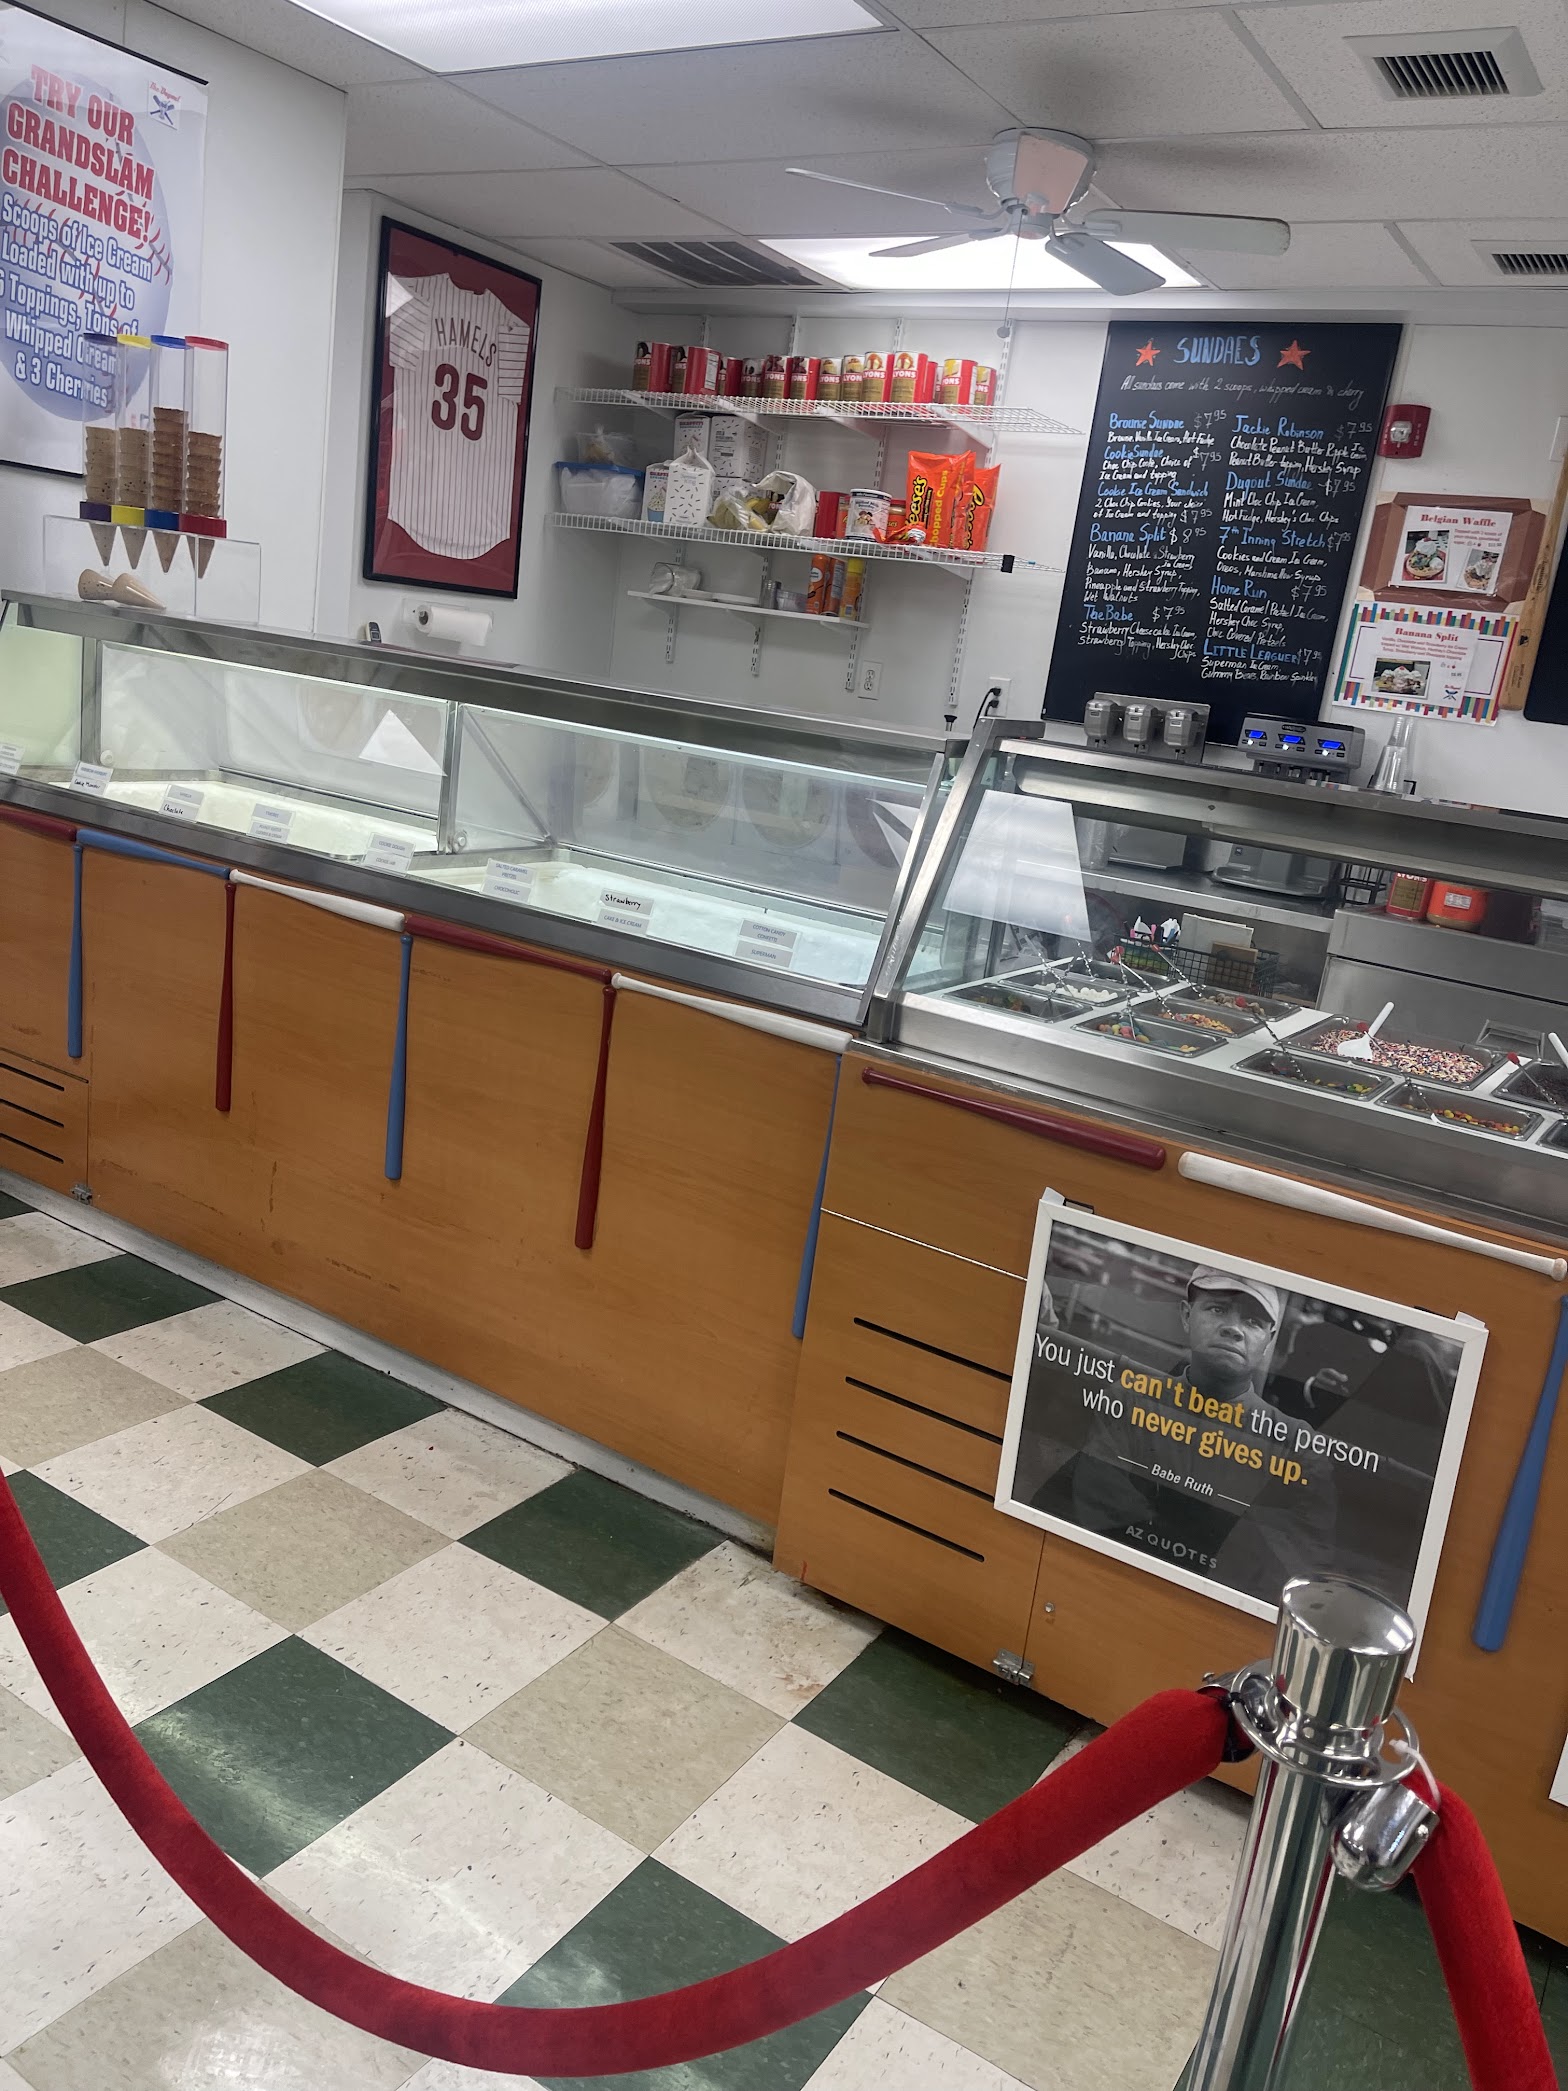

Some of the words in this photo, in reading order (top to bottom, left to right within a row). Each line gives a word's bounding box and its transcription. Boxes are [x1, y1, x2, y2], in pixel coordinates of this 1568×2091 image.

[31, 64, 81, 118] TRY
[87, 95, 134, 146] OUR
[8, 103, 154, 200] GRANDSLAM
[3, 149, 151, 243] CHALLENGE!
[2, 193, 58, 241] Scoops
[62, 220, 80, 249] of
[80, 225, 103, 260] Ice
[106, 237, 152, 282] Cream
[2, 232, 56, 279] Loaded
[61, 260, 94, 293] with
[97, 276, 116, 307] up
[119, 280, 135, 310] to
[9, 273, 80, 330] Toppings,
[85, 301, 118, 337] Tons
[5, 309, 77, 360] Whipped
[434, 318, 496, 367] HAMELS
[1173, 336, 1260, 366] SUNDAES
[15, 350, 26, 380] &
[31, 357, 42, 385] 3
[1188, 377, 1209, 391] with
[1214, 378, 1223, 390] 2
[431, 363, 488, 441] 35
[1109, 412, 1147, 429] Brownie
[1232, 415, 1271, 435] Jackie
[1277, 416, 1324, 439] Robinson
[1104, 444, 1133, 459] Cookie
[1133, 443, 1164, 458] Sundae
[1230, 435, 1268, 451] Chocolate
[1269, 437, 1295, 453] Peanut
[1297, 439, 1325, 455] Butter
[1183, 456, 1192, 468] of
[1229, 451, 1251, 466] Peanut
[1251, 453, 1277, 467] Butter
[936, 470, 949, 497] Cups
[1097, 481, 1127, 497] Cookie
[1128, 482, 1143, 496] Ice
[1144, 482, 1168, 497] Cream
[1170, 481, 1208, 498] Sandwich
[1225, 471, 1271, 499] Dugout
[1275, 474, 1313, 491] Sundae
[905, 475, 927, 525] eese's
[1095, 498, 1102, 508] 2
[1223, 492, 1247, 508] Mint
[1265, 491, 1282, 516] Chip
[930, 500, 943, 547] hopped
[1093, 509, 1103, 518] of
[1136, 509, 1150, 518] and
[1222, 509, 1237, 523] Hot
[1420, 514, 1458, 524] Belgian
[1463, 516, 1496, 527] Waffle
[1090, 522, 1135, 542] Banana
[1139, 522, 1167, 549] Split
[1240, 527, 1277, 551] Inning
[1281, 530, 1326, 548] Stretch
[1119, 544, 1151, 560] Chocolate
[1217, 545, 1250, 562] Cookies
[1251, 551, 1265, 562] and
[1264, 550, 1287, 564] Cream
[1122, 563, 1153, 582] Hershey
[1244, 565, 1294, 580] Marshmallow
[1083, 591, 1098, 603] Wet
[1085, 576, 1121, 594] Pineapple
[1123, 579, 1138, 591] and
[1139, 579, 1178, 600] Strawberry
[1210, 575, 1241, 596] Home
[1244, 579, 1267, 598] Run
[1083, 604, 1104, 620] The
[1105, 604, 1134, 620] Babe
[1209, 597, 1241, 611] Salted
[1240, 600, 1270, 614] Caramel
[1208, 611, 1240, 632] Hershey
[1395, 628, 1432, 639] Banana
[1435, 632, 1459, 642] Split
[1203, 638, 1247, 659] LITTLE
[1250, 644, 1300, 664] LEAGUER
[1201, 656, 1247, 670] Superman
[1201, 668, 1233, 682] Gummy
[604, 893, 641, 910] Strawberry
[627, 920, 642, 928] CREAM
[752, 924, 770, 933] COTTON
[770, 928, 786, 937] CANDY
[750, 949, 777, 960] SUPERMAN
[1034, 1334, 1070, 1368] You
[1074, 1347, 1114, 1384] just
[1121, 1366, 1182, 1407] can't
[1188, 1384, 1244, 1428] beat
[1251, 1408, 1287, 1442] the
[1295, 1427, 1379, 1472] person
[1082, 1388, 1124, 1420] who
[1131, 1405, 1196, 1445] never
[1199, 1428, 1263, 1469] gives
[1269, 1455, 1308, 1486] up.
[1151, 1463, 1181, 1484] Babe
[1184, 1476, 1213, 1496] Ruth
[1125, 1525, 1143, 1541] AZ
[1147, 1532, 1218, 1569] QUOTES
